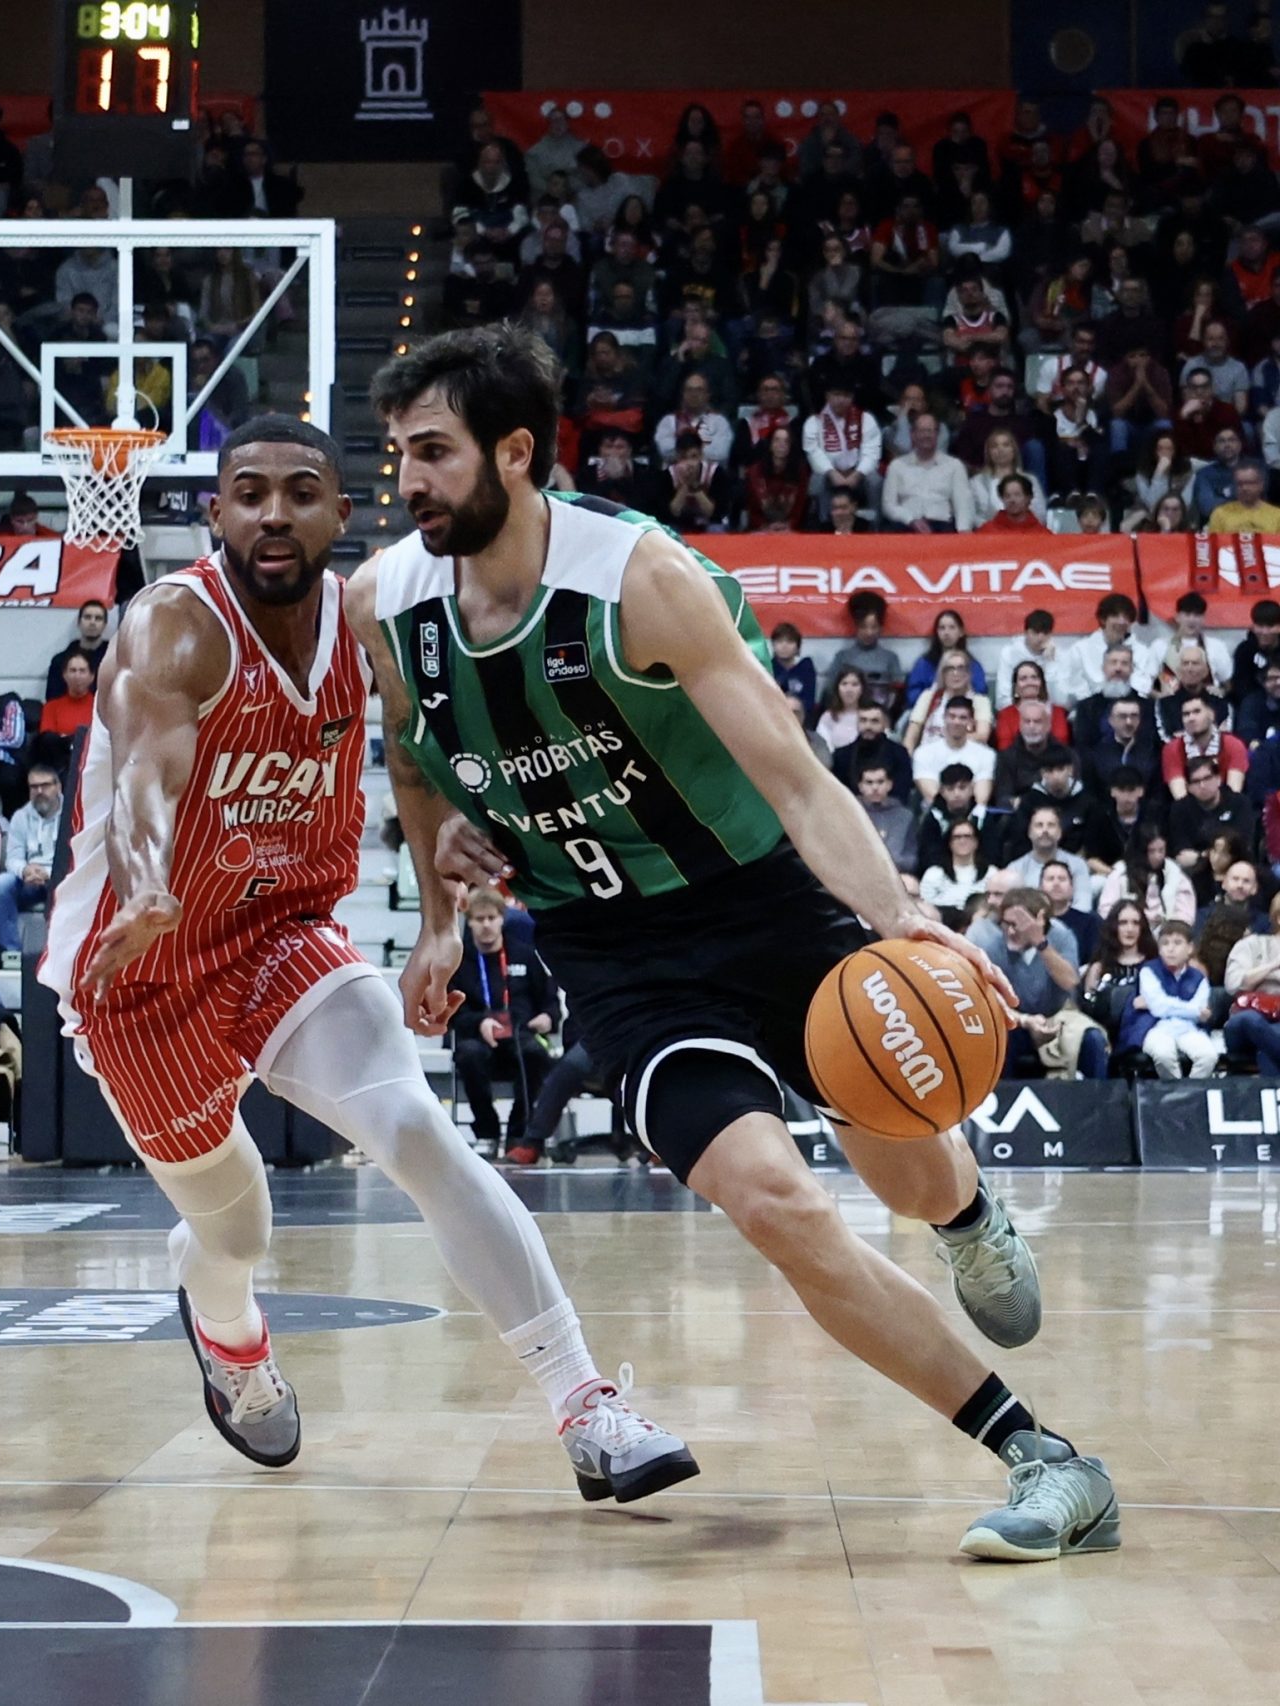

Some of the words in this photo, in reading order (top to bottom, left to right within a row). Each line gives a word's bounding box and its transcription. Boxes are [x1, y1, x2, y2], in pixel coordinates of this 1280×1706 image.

[100, 1, 170, 40] 3:04
[906, 560, 1113, 594] VITAE
[497, 730, 623, 786] PROBITAS
[223, 799, 315, 830] MURCIA
[564, 838, 623, 899] 9
[244, 937, 305, 1017] NVERSUS
[862, 970, 944, 1101] Wilson
